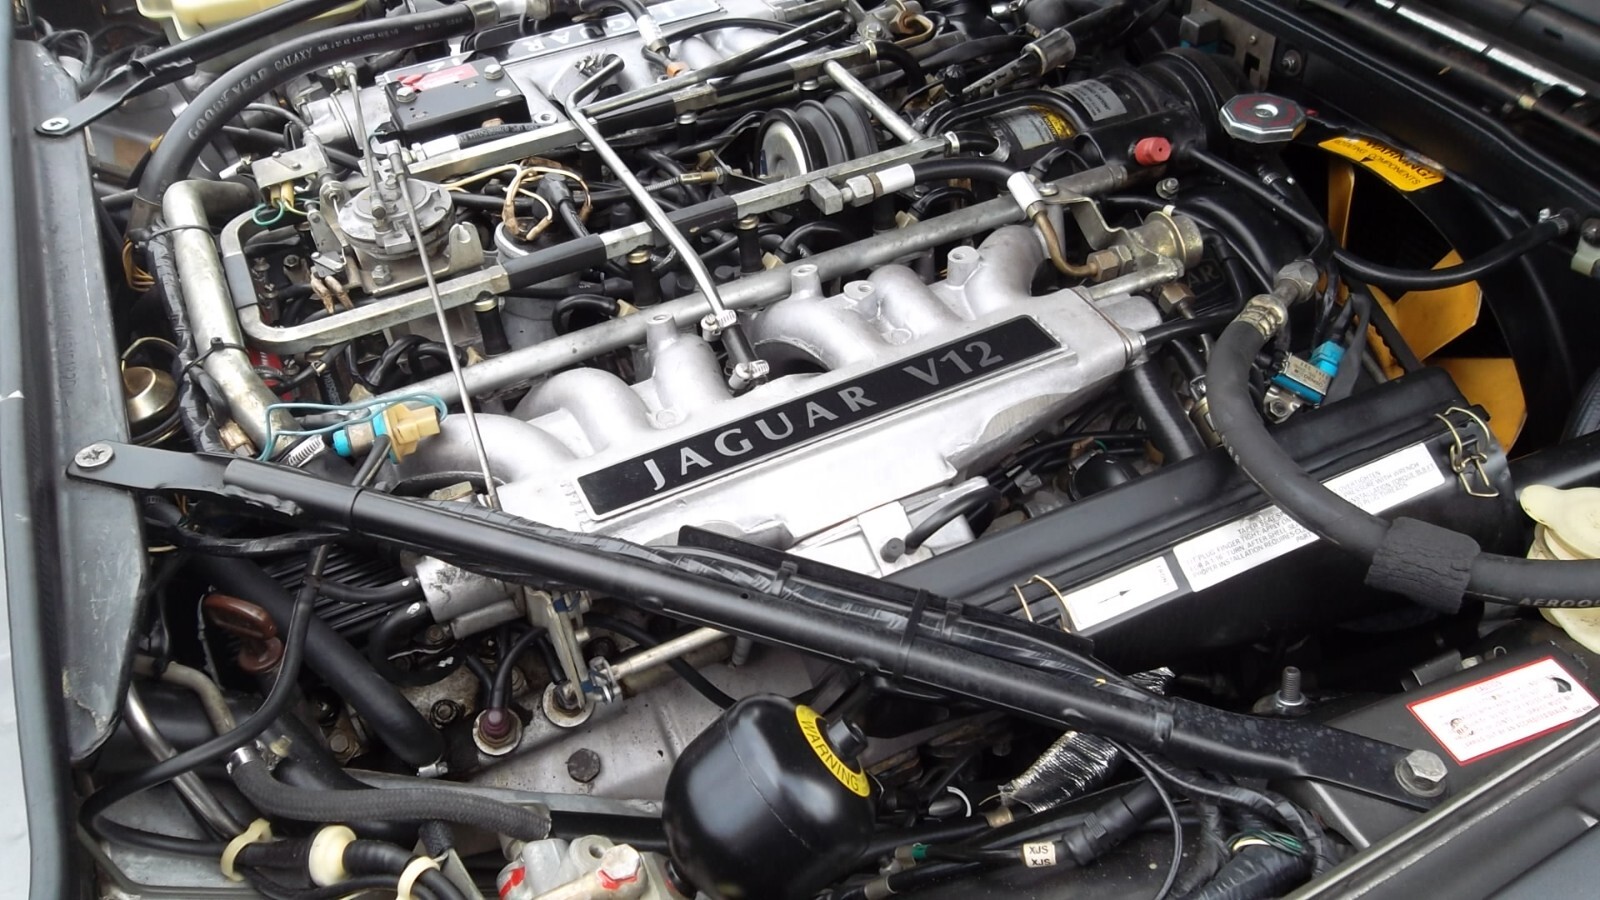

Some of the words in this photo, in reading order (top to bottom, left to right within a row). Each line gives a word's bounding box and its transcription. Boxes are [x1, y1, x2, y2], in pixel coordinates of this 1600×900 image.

[274, 47, 313, 71] GALAXY
[1368, 153, 1421, 185] COMPONENTS
[643, 386, 877, 492] JAGUAR
[903, 339, 1004, 387] V12
[1237, 522, 1259, 536] TAPER
[801, 719, 859, 793] WARNING
[1029, 845, 1049, 855] XJS
[1031, 858, 1052, 866] XJS
